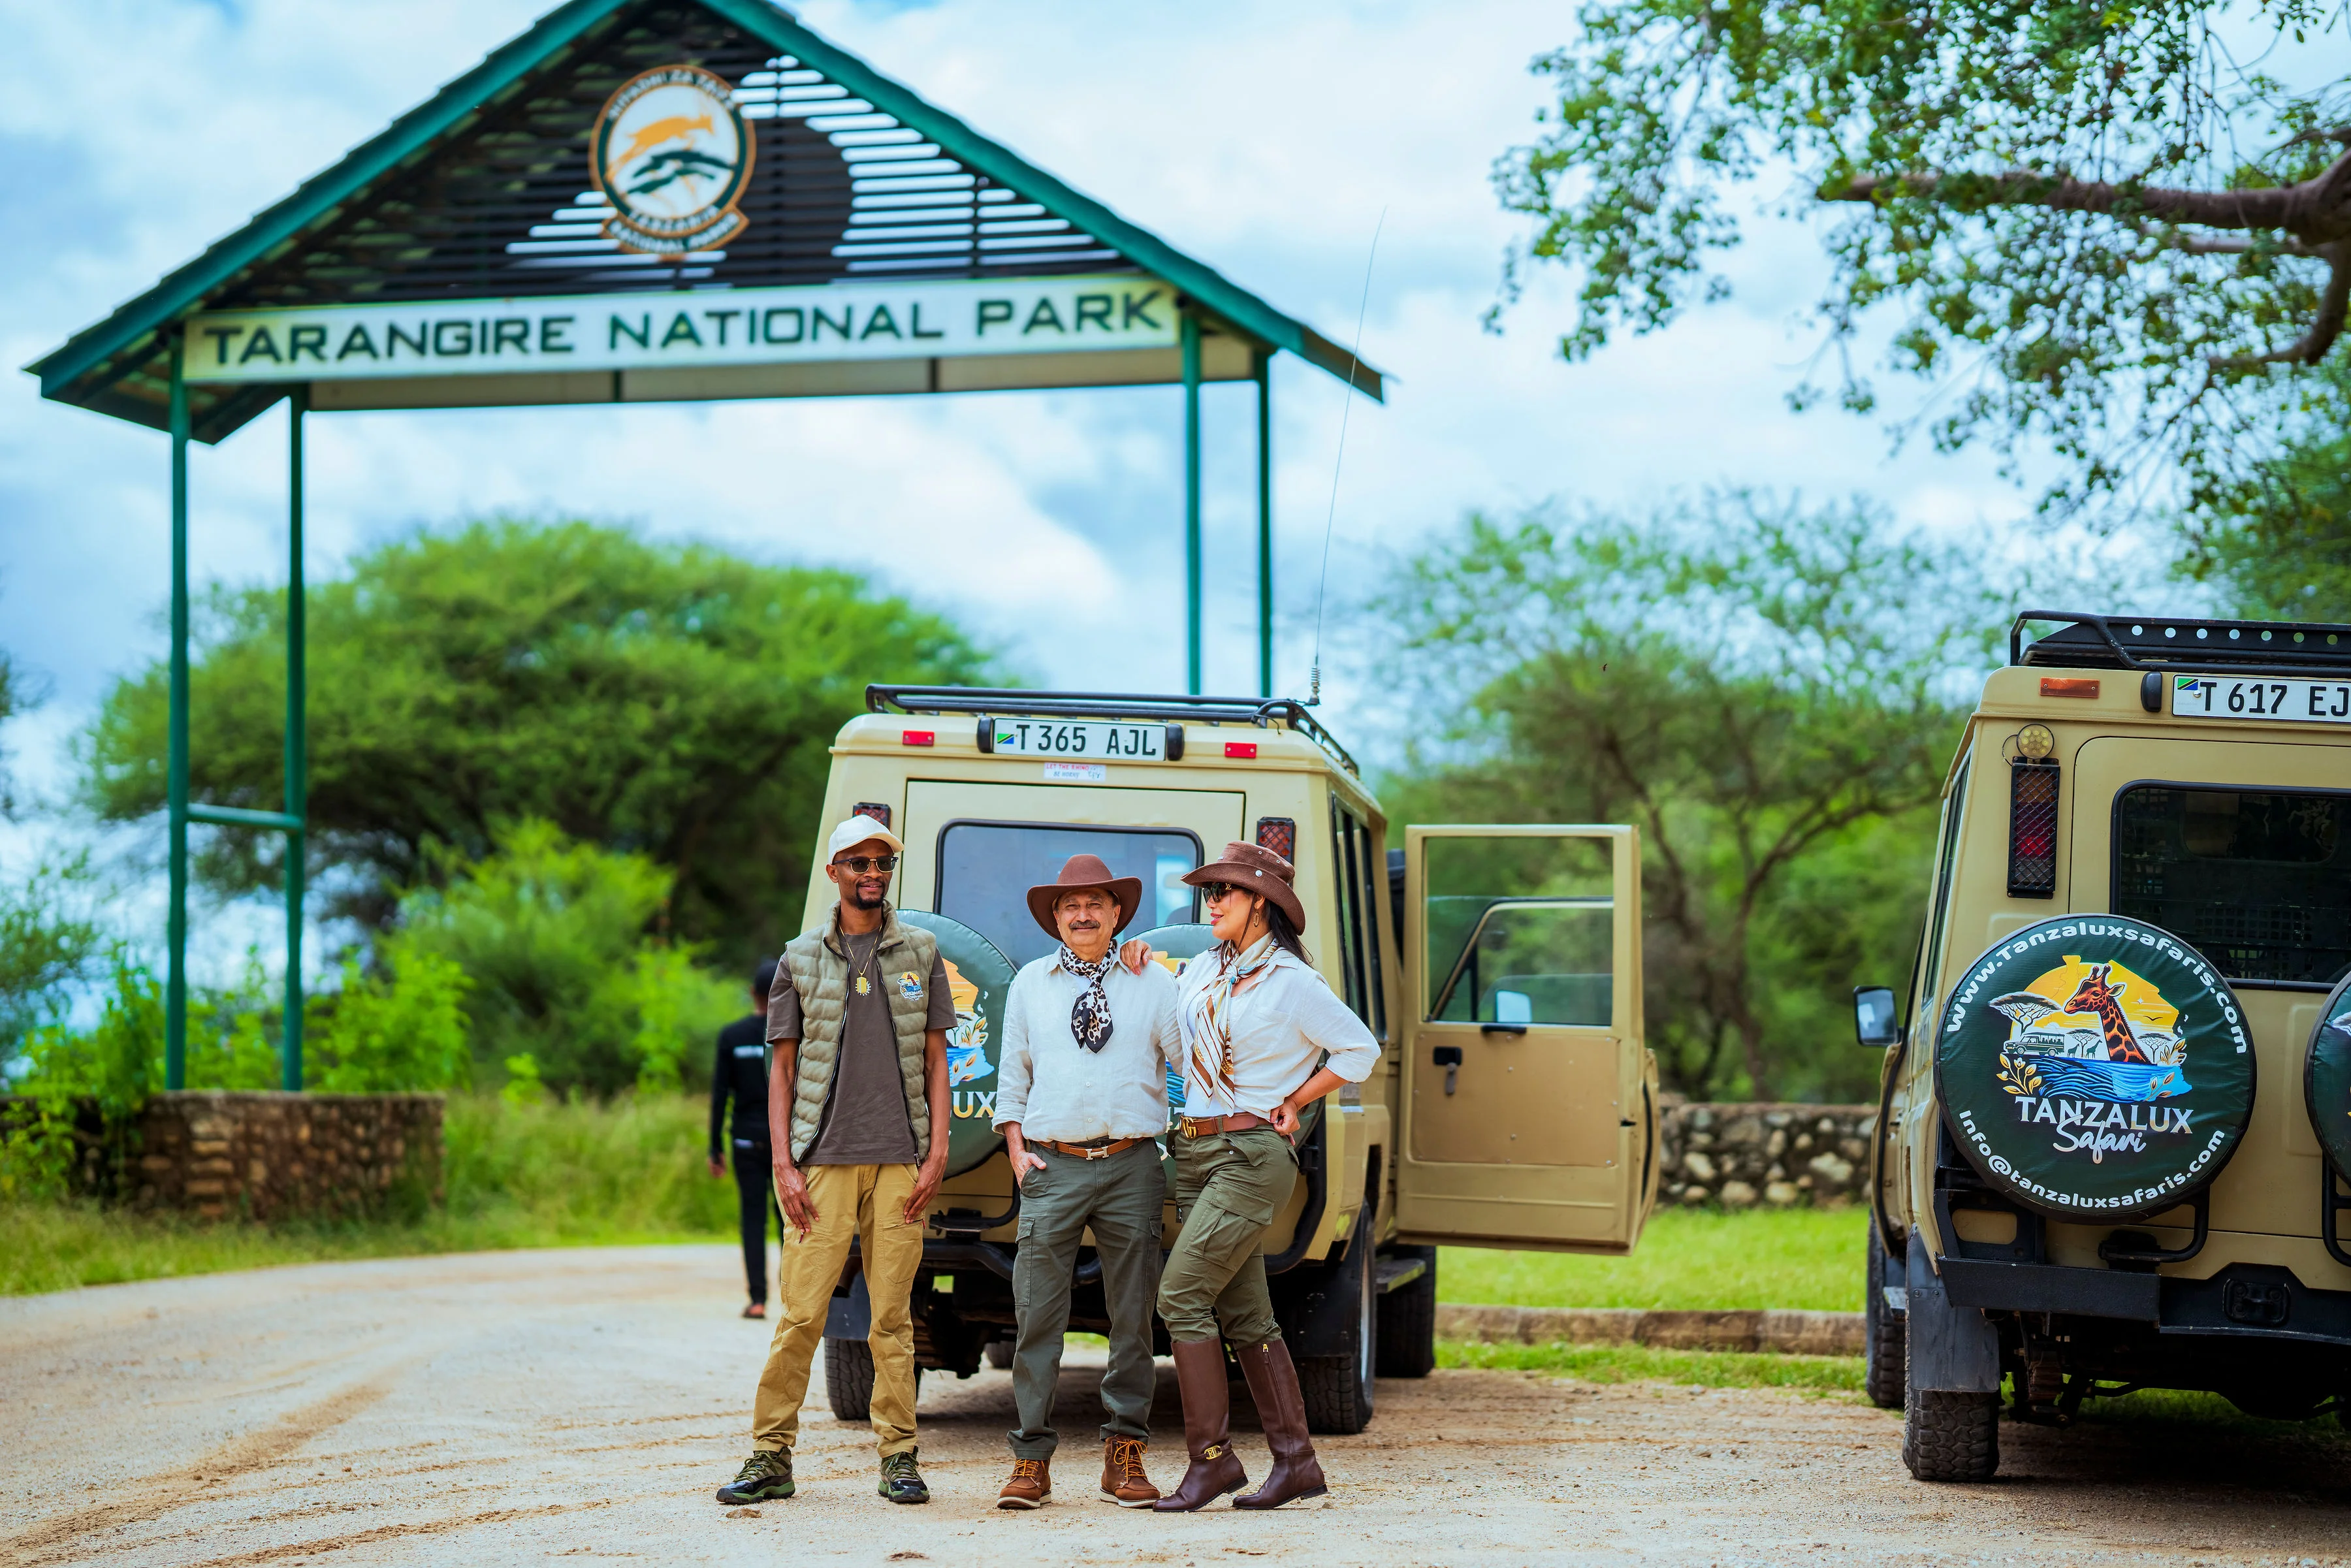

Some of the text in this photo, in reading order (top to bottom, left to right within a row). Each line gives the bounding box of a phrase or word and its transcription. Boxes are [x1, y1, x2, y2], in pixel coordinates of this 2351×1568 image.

[204, 290, 1162, 364] TARANGIRE NATIONAL PARK
[2199, 682, 2217, 711] T
[2228, 683, 2287, 713] 617
[1016, 724, 1157, 756] T 365 AJL
[2015, 1096, 2193, 1134] TANZALUX
[2053, 1114, 2147, 1164] Safari
